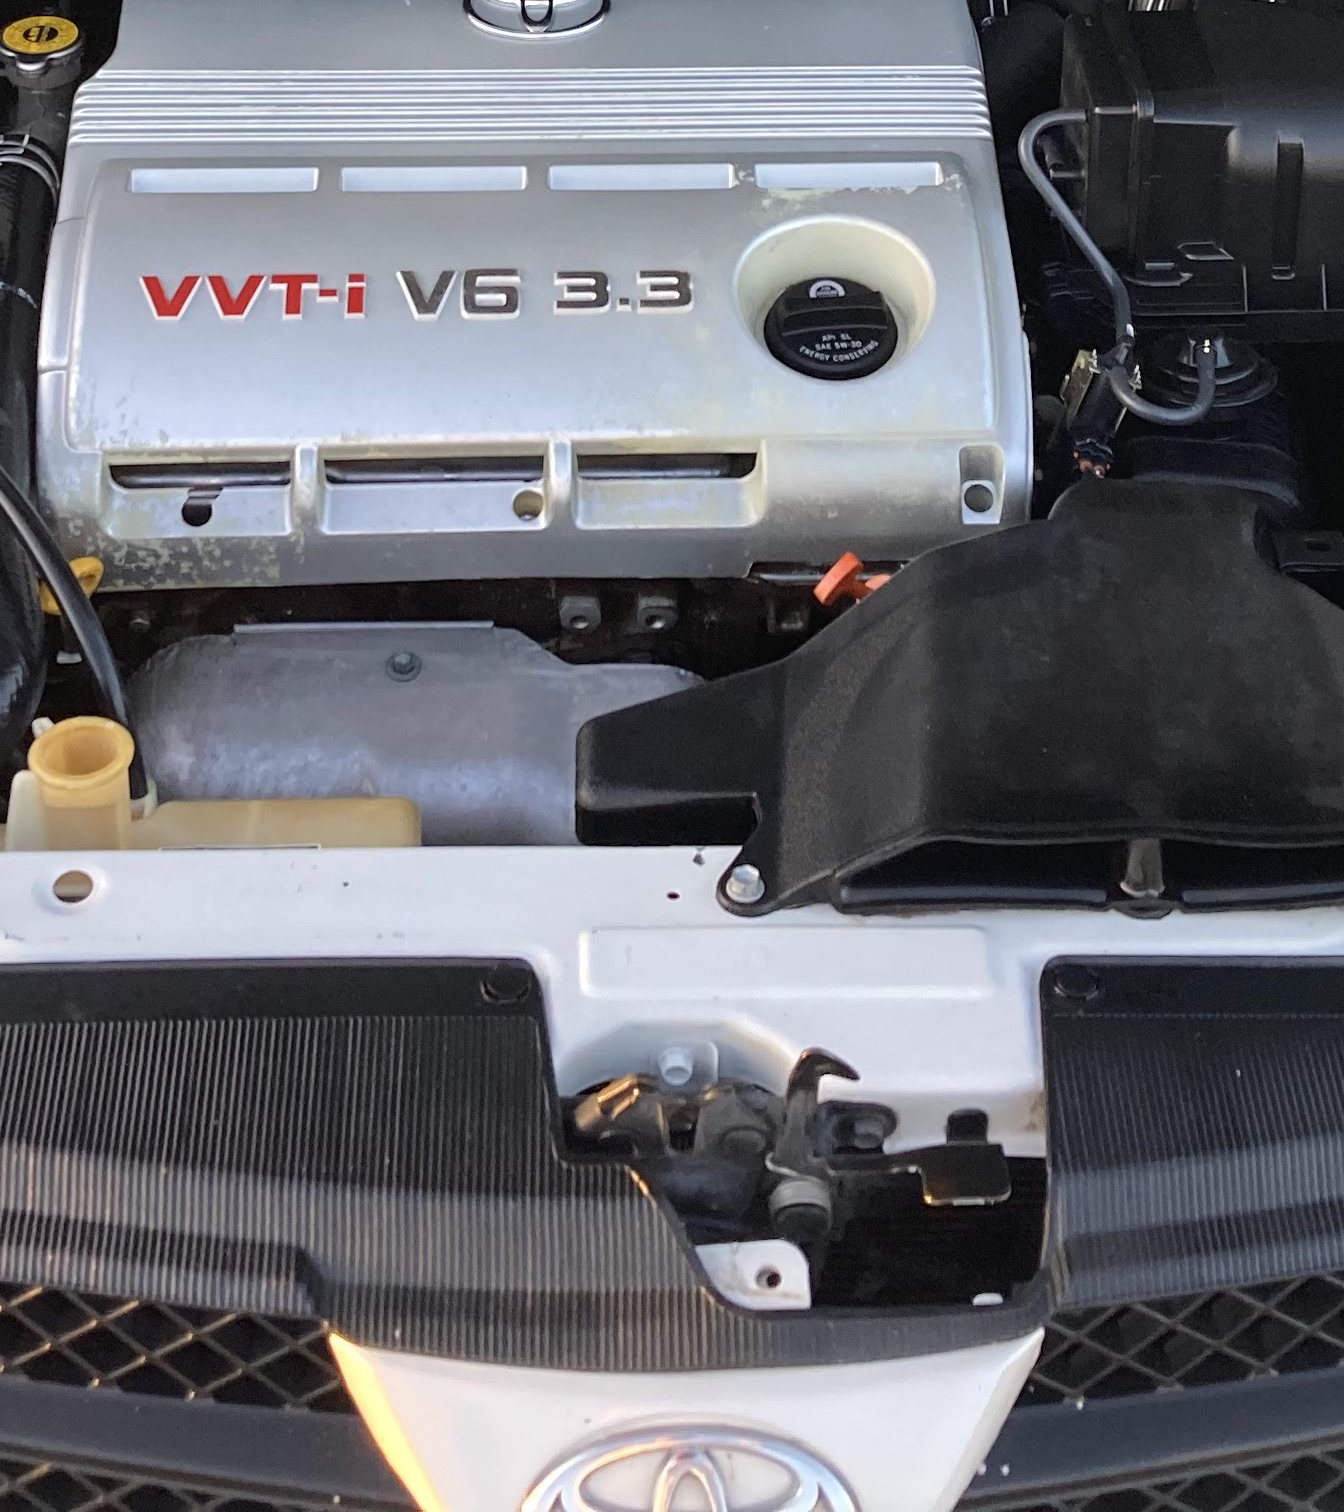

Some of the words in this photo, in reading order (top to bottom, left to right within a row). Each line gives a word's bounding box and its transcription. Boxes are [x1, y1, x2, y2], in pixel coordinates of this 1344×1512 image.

[139, 273, 367, 320] VVT-i
[396, 268, 521, 321] V6
[553, 269, 695, 316] 3.3
[834, 340, 863, 350] 5W-30
